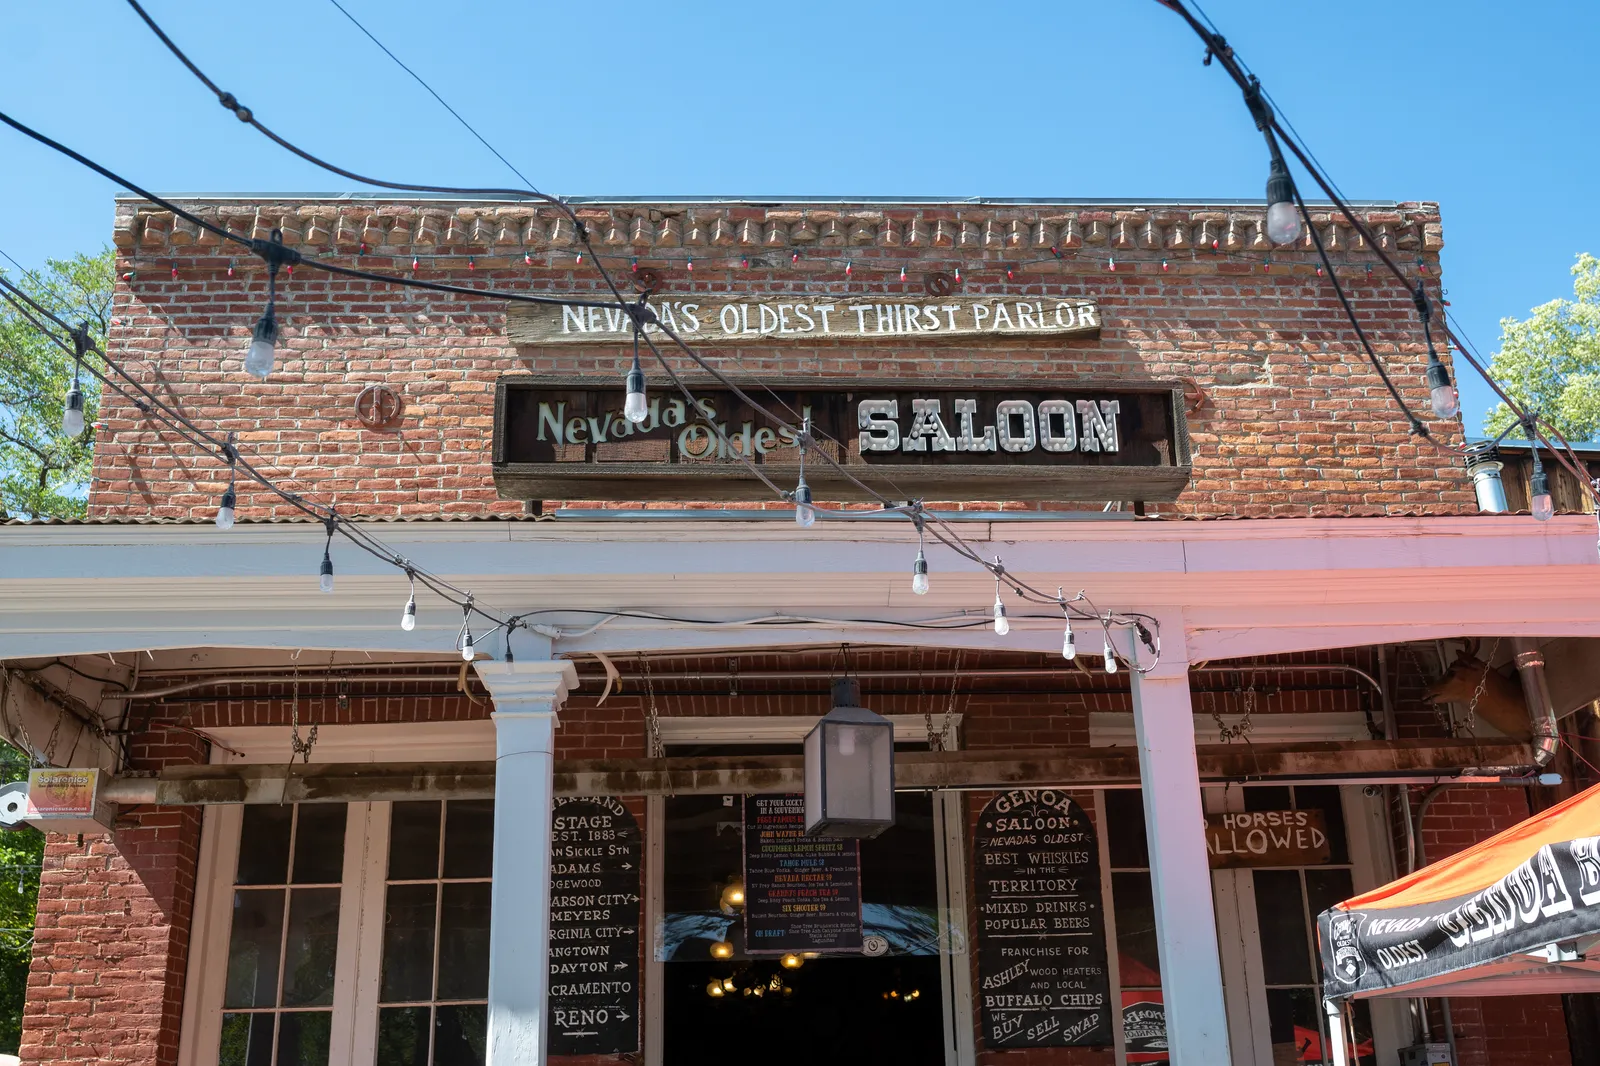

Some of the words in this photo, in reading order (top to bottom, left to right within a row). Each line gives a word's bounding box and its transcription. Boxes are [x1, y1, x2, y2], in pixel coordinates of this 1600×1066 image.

[719, 303, 835, 334] OLDEST
[849, 303, 961, 333] THIRST
[972, 301, 1097, 330] PARLOR
[857, 399, 1119, 453] SALOON
[995, 790, 1071, 815] GENOA
[554, 816, 612, 830] STAGE
[996, 817, 1070, 832] SALOON
[1223, 811, 1308, 830] HORSES
[552, 831, 582, 842] EST.
[588, 830, 616, 841] 1883
[990, 835, 1037, 847] NEVADA'S
[1043, 833, 1083, 844] OLDEST
[984, 853, 1018, 865] BEST
[1027, 851, 1089, 864] WHISKIES
[1040, 866, 1056, 874] THE
[551, 879, 602, 889] DGEWOOD
[988, 879, 1079, 893] TERRITORY
[551, 894, 595, 907] ARSON
[597, 893, 632, 906] CITY
[1437, 844, 1574, 948] GENOA
[985, 902, 1028, 914] MIXED
[1036, 901, 1087, 913] DRINKS
[551, 910, 611, 921] MEYERS
[984, 919, 1047, 930] POPULAR
[1053, 917, 1090, 929] BEERS
[549, 928, 592, 940] RGINIA
[595, 926, 624, 938] CITY
[549, 946, 610, 957] ANGTOWN
[1001, 947, 1062, 956] FRANCHISE
[1067, 946, 1089, 956] FOR
[1376, 939, 1428, 970] OLDEST
[550, 961, 608, 974] DAYTON
[982, 958, 1030, 989] ASHLEY
[1030, 967, 1058, 976] WOOD
[1062, 967, 1102, 976] HEATERS
[548, 981, 631, 996] CRAMENTO
[1030, 981, 1050, 989] AND
[1056, 981, 1087, 989] LOCAL
[985, 994, 1052, 1007] BUFFALO
[1060, 993, 1103, 1006] CHIPS
[554, 1009, 609, 1028] RENO
[991, 1012, 1007, 1022] WE
[993, 1014, 1023, 1040] BUY
[1027, 1016, 1060, 1040] SELL
[1063, 1013, 1099, 1041] SWAP
